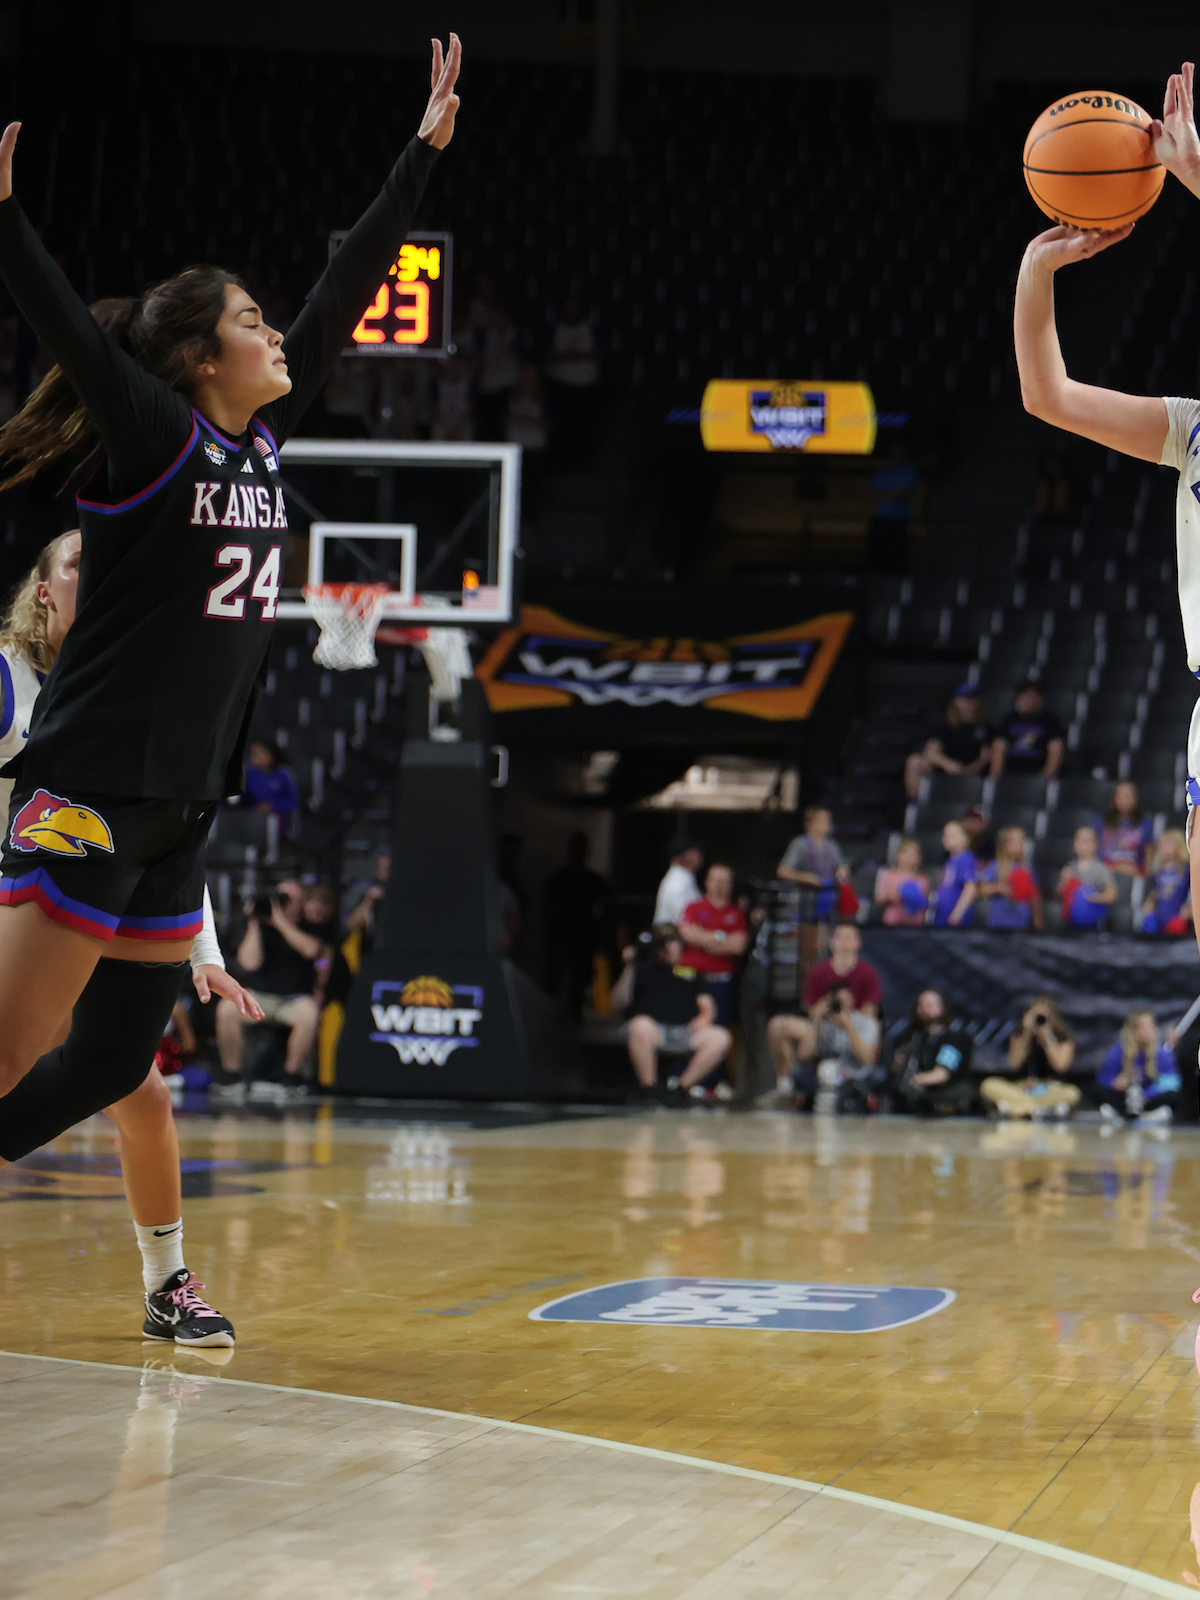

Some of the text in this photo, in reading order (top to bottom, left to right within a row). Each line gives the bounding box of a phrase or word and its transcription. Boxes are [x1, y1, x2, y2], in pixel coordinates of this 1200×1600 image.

[1049, 96, 1143, 122] Wilson
[388, 244, 440, 282] 34
[352, 281, 430, 344] 23
[190, 481, 288, 529] KANSA
[203, 543, 282, 621] 24
[519, 651, 804, 683] WBIT
[371, 1004, 482, 1036] WBIT
